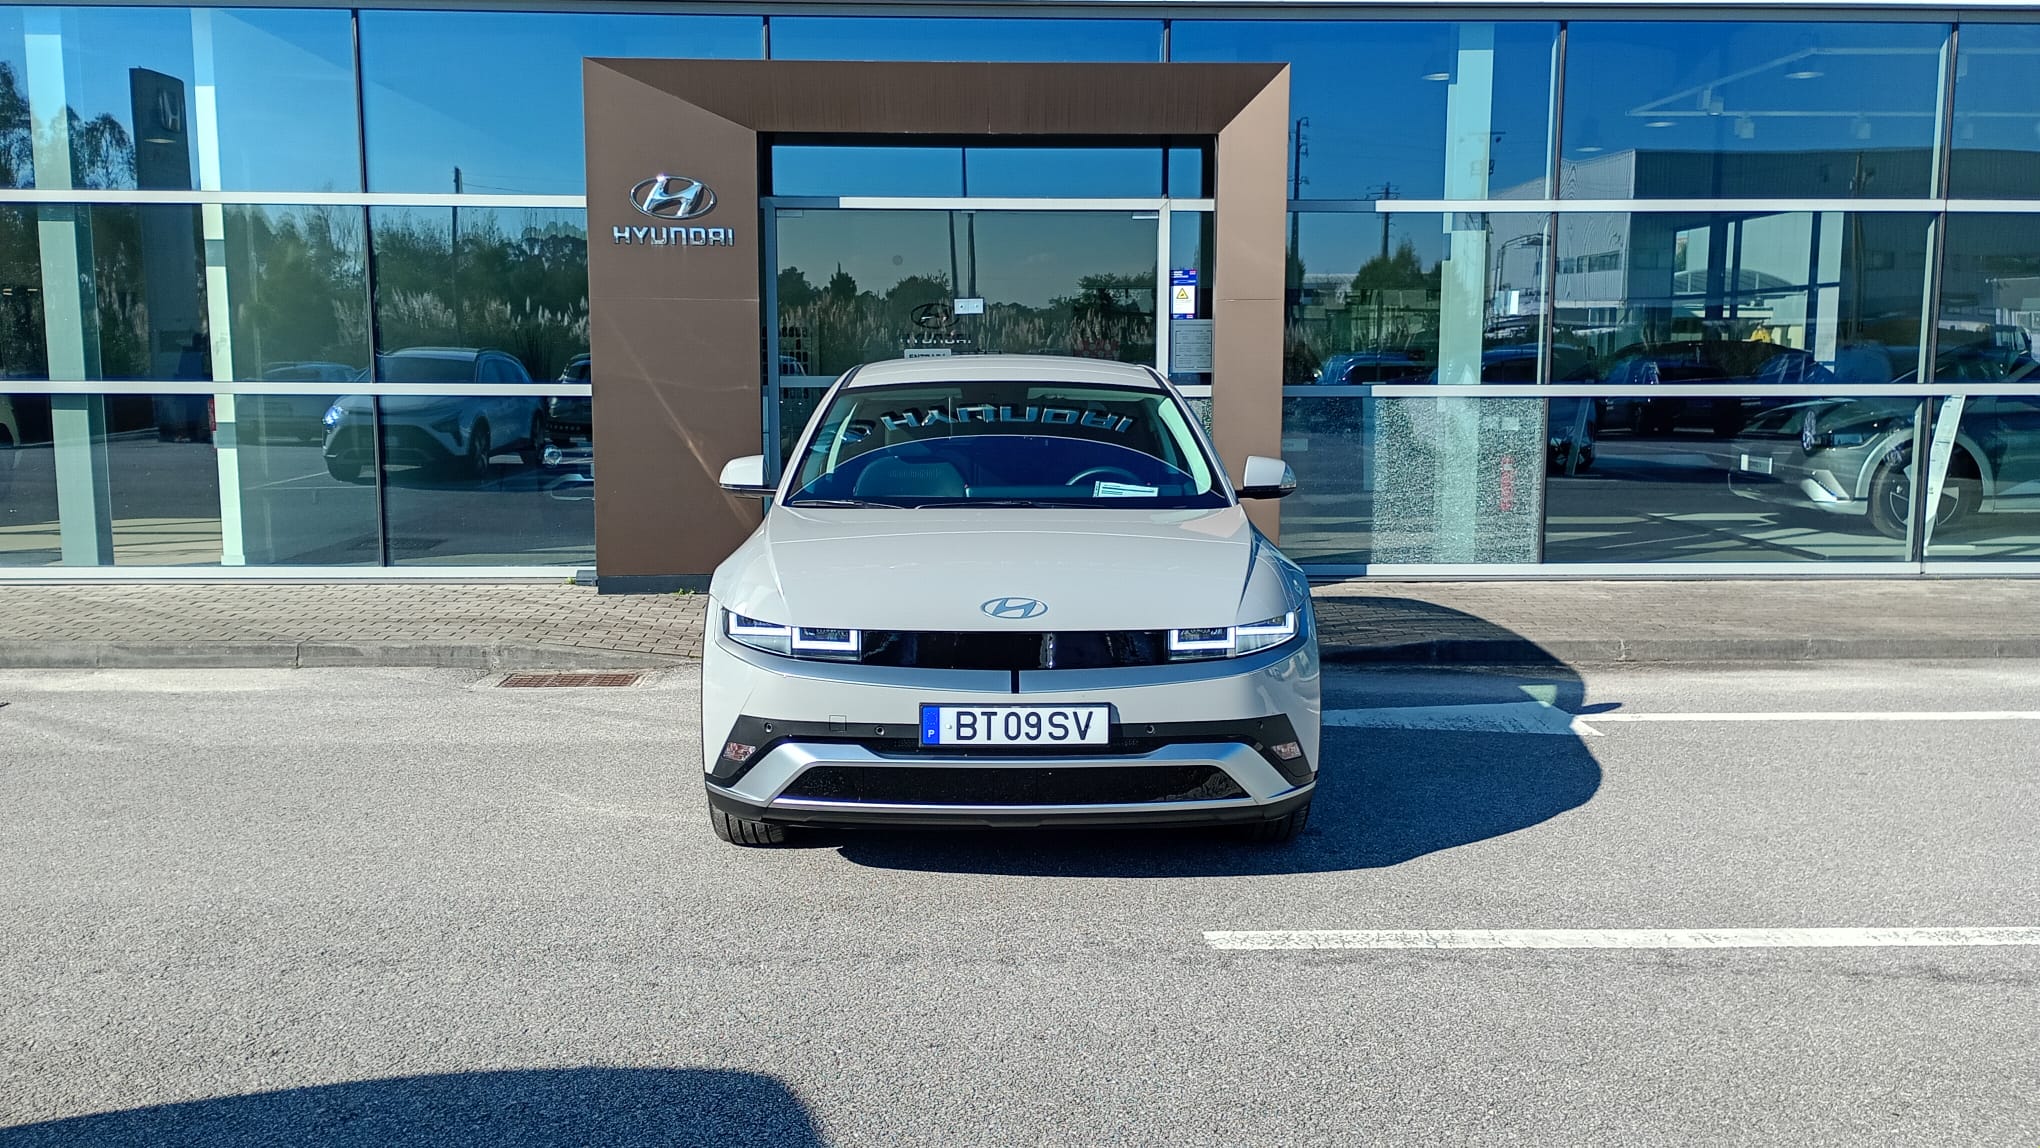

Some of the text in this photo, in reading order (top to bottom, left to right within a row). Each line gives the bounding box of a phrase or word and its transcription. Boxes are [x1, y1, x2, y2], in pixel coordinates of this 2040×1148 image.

[612, 226, 735, 246] HYUNDAI
[927, 729, 935, 738] P
[956, 711, 1094, 741] BT 09 SV
